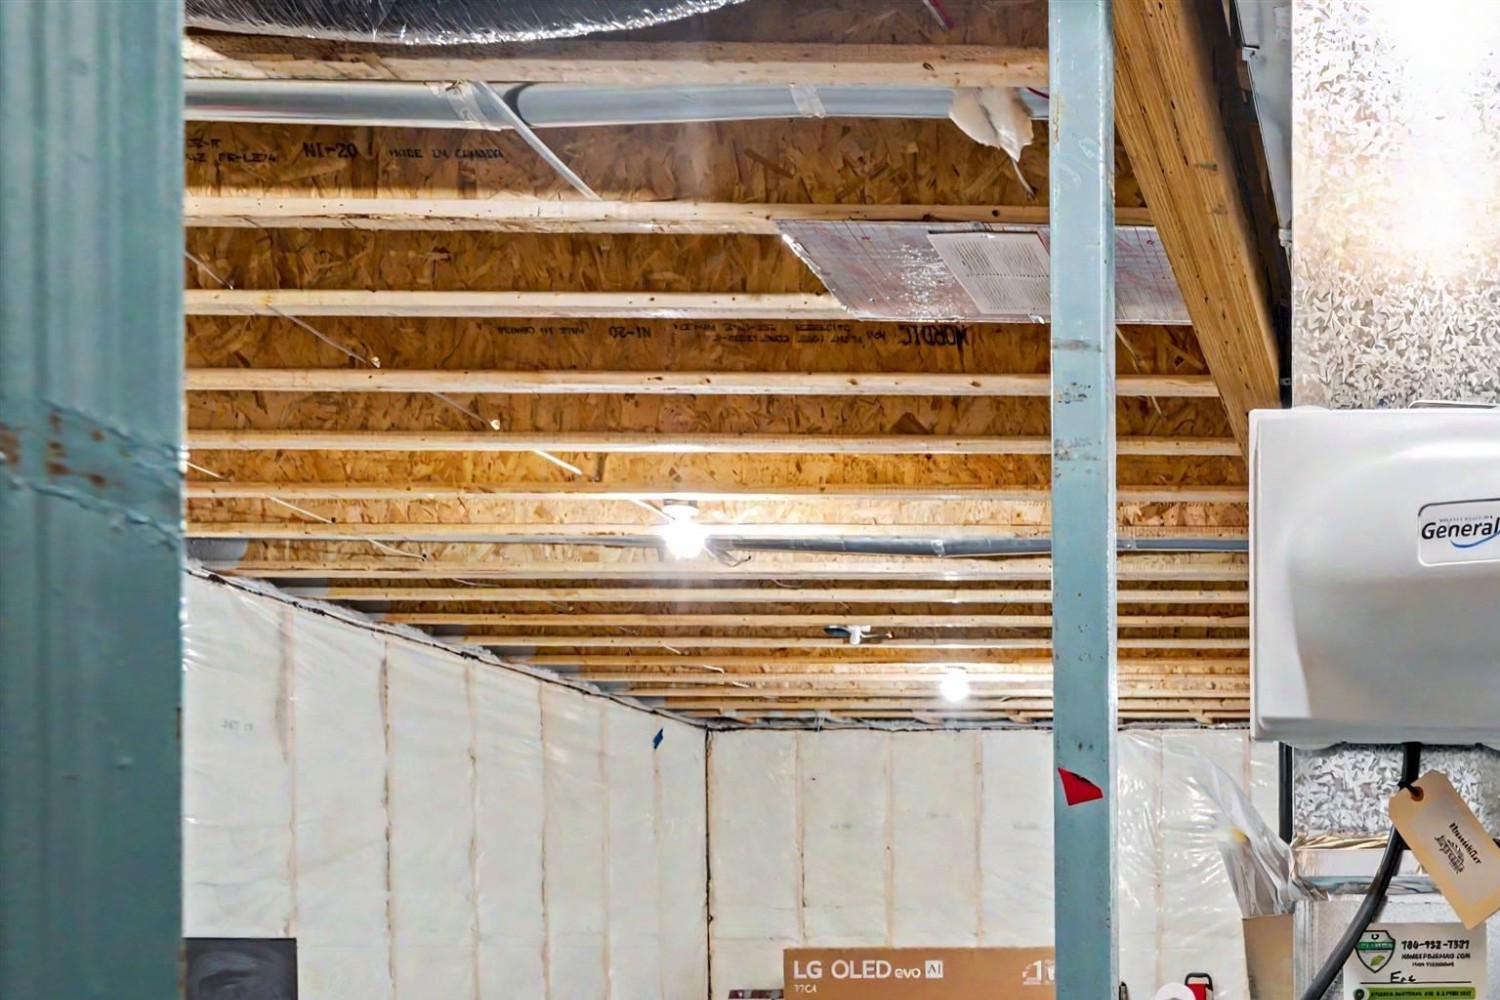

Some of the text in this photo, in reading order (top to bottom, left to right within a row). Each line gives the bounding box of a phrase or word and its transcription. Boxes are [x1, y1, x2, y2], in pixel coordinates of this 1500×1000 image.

[793, 960, 823, 979] LG
[831, 960, 892, 979] OLED
[894, 967, 921, 979] evo
